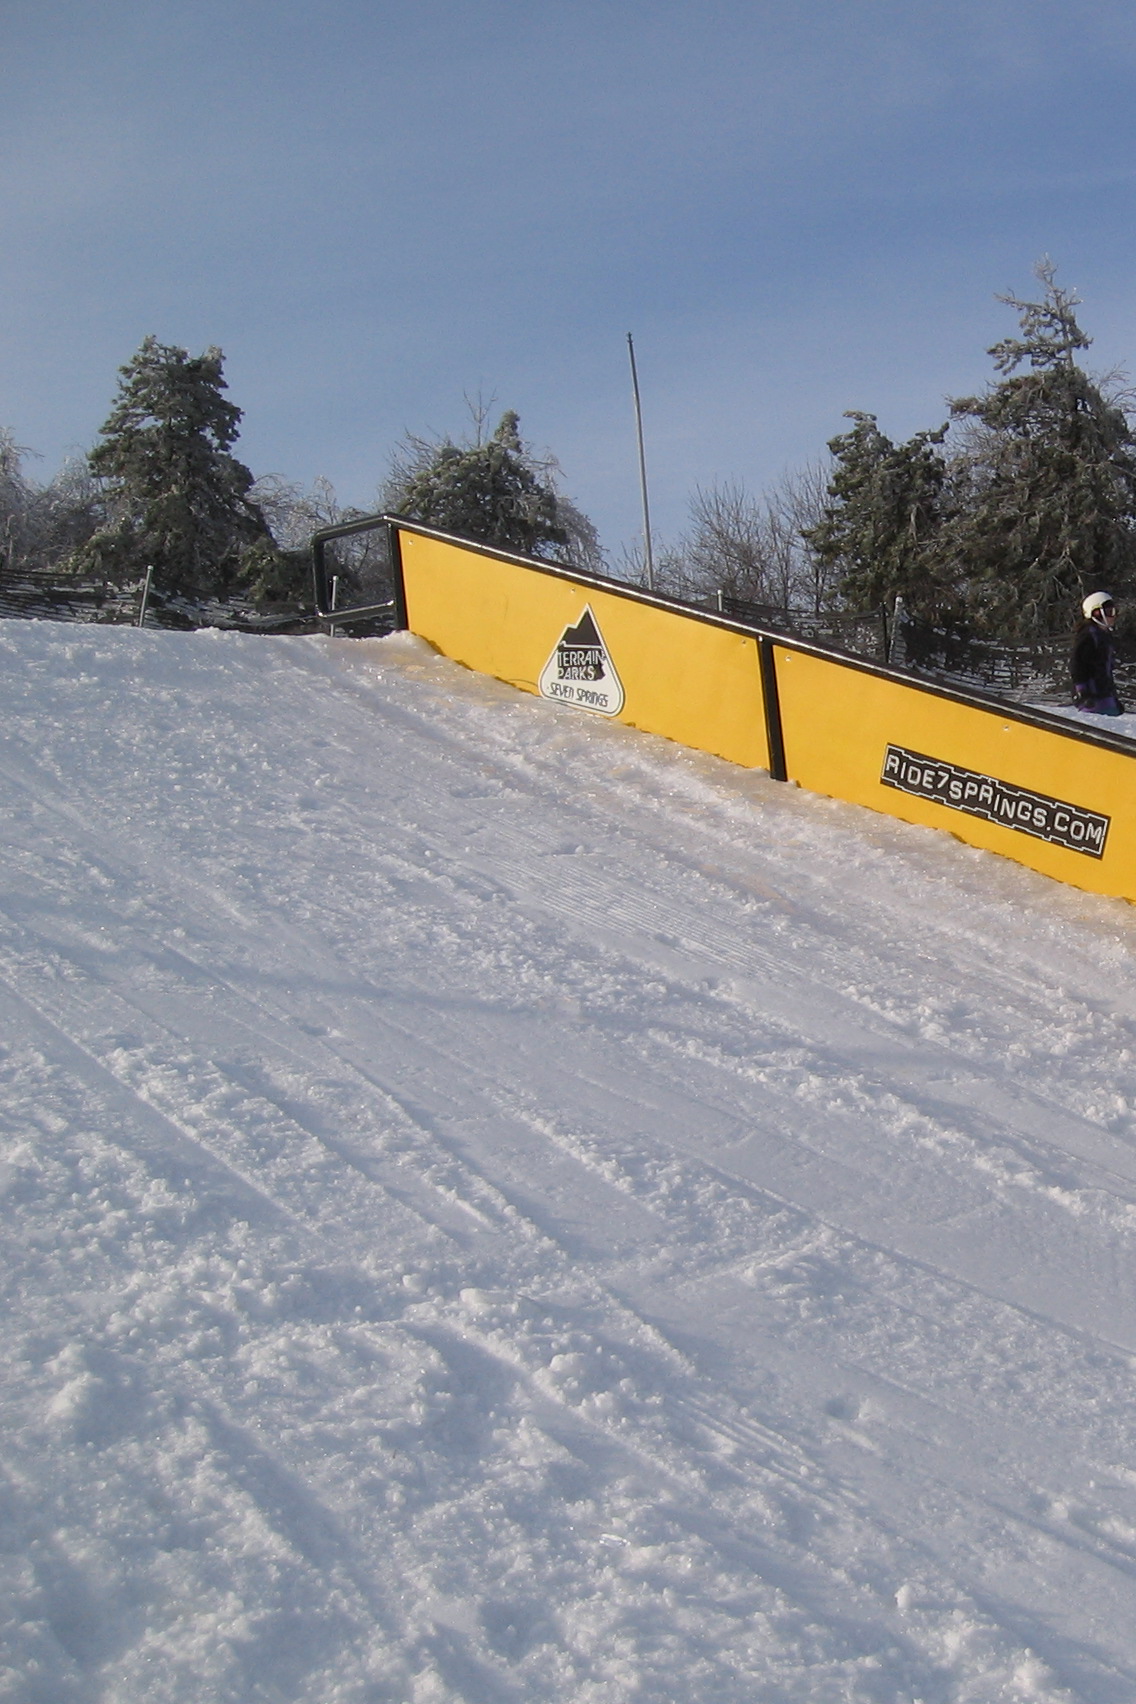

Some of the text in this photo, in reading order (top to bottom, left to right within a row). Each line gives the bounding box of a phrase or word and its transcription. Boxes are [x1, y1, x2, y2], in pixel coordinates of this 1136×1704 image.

[557, 666, 595, 680] PARKS
[550, 682, 608, 707] SEVEN SPRINGS
[885, 754, 1103, 845] RIDE7SPRINGS.COM
